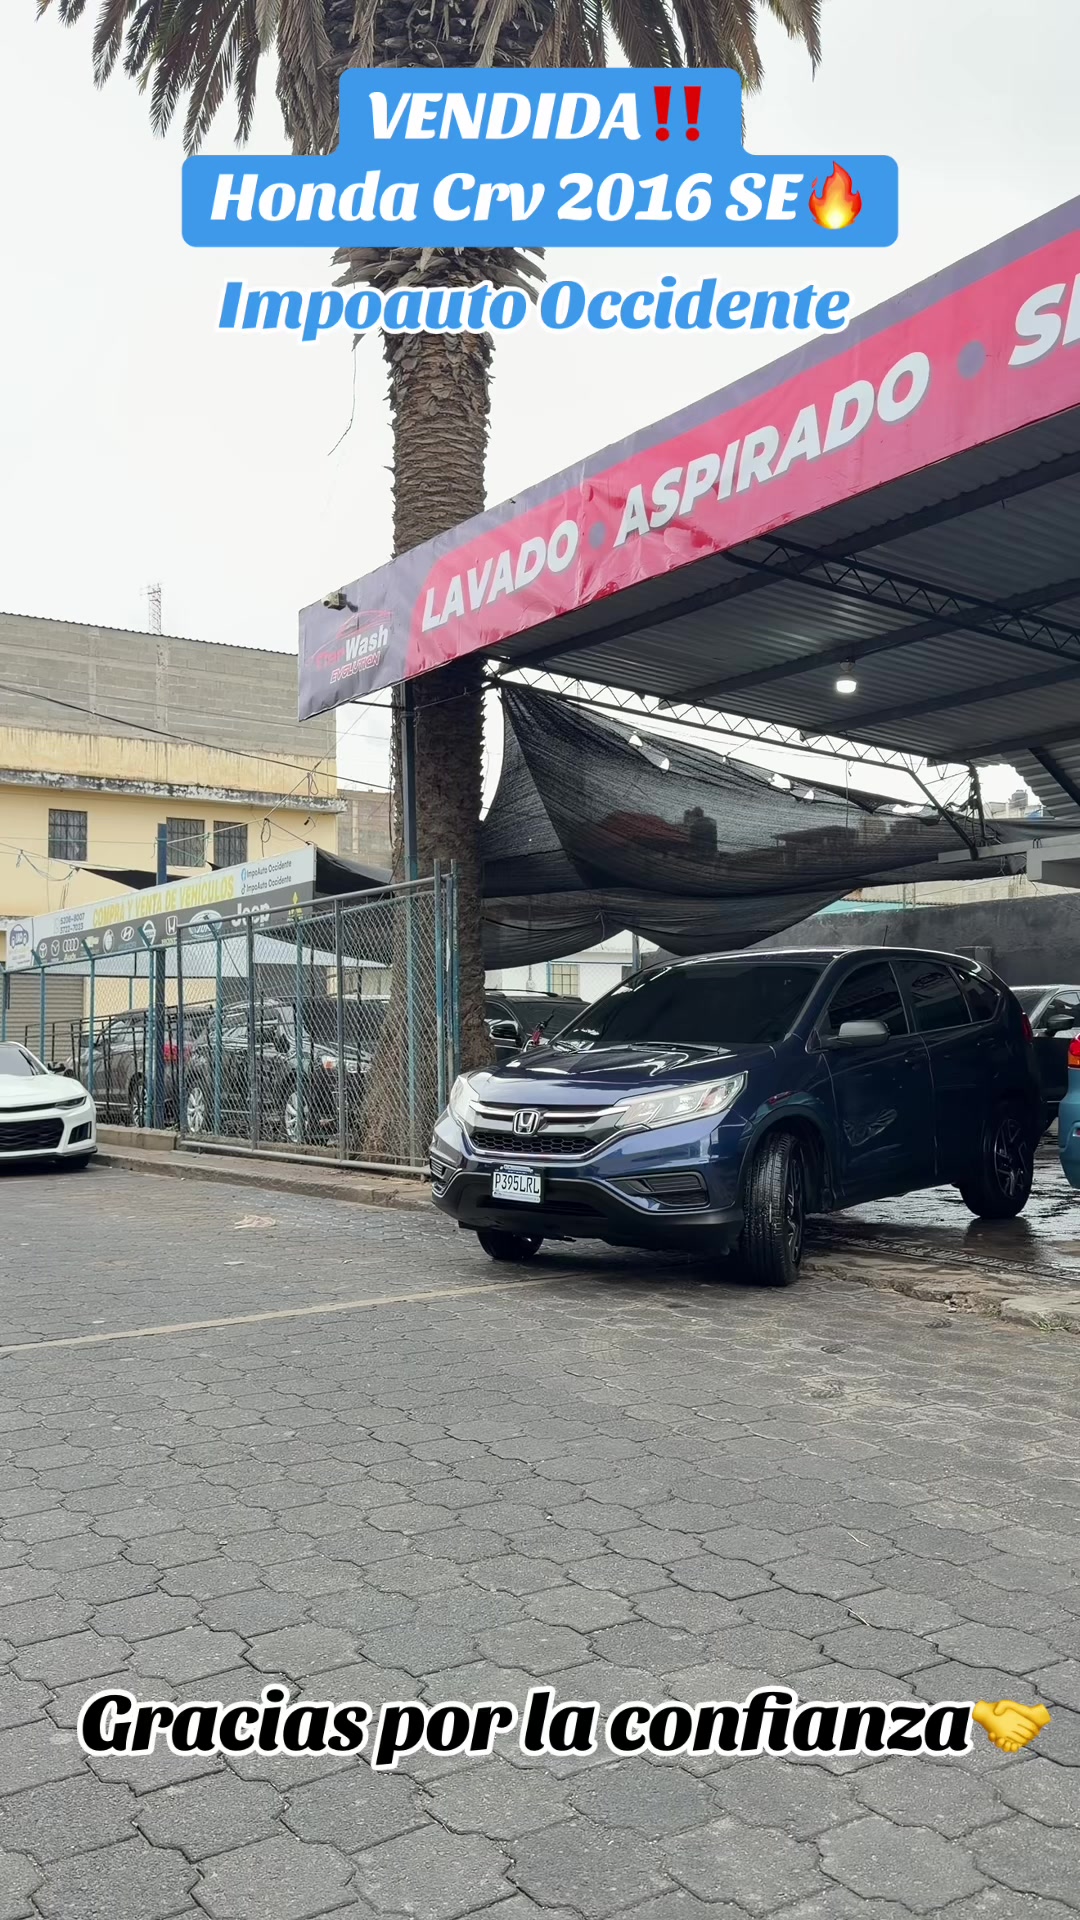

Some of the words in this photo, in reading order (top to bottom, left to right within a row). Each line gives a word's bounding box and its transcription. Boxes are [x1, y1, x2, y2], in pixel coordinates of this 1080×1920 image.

[422, 520, 579, 632] LAVADO
[613, 351, 930, 548] ASPIRADO
[345, 624, 389, 662] Wash
[329, 650, 381, 684] EVOLUTION
[268, 860, 292, 873] Occidente
[268, 875, 292, 888] Occidente
[92, 900, 125, 927] COMPRA
[127, 897, 134, 917] Y
[135, 890, 162, 917] VENTA
[165, 888, 177, 911] DE
[180, 875, 235, 909] VEHICULOS
[495, 1173, 540, 1194] P395LRL
